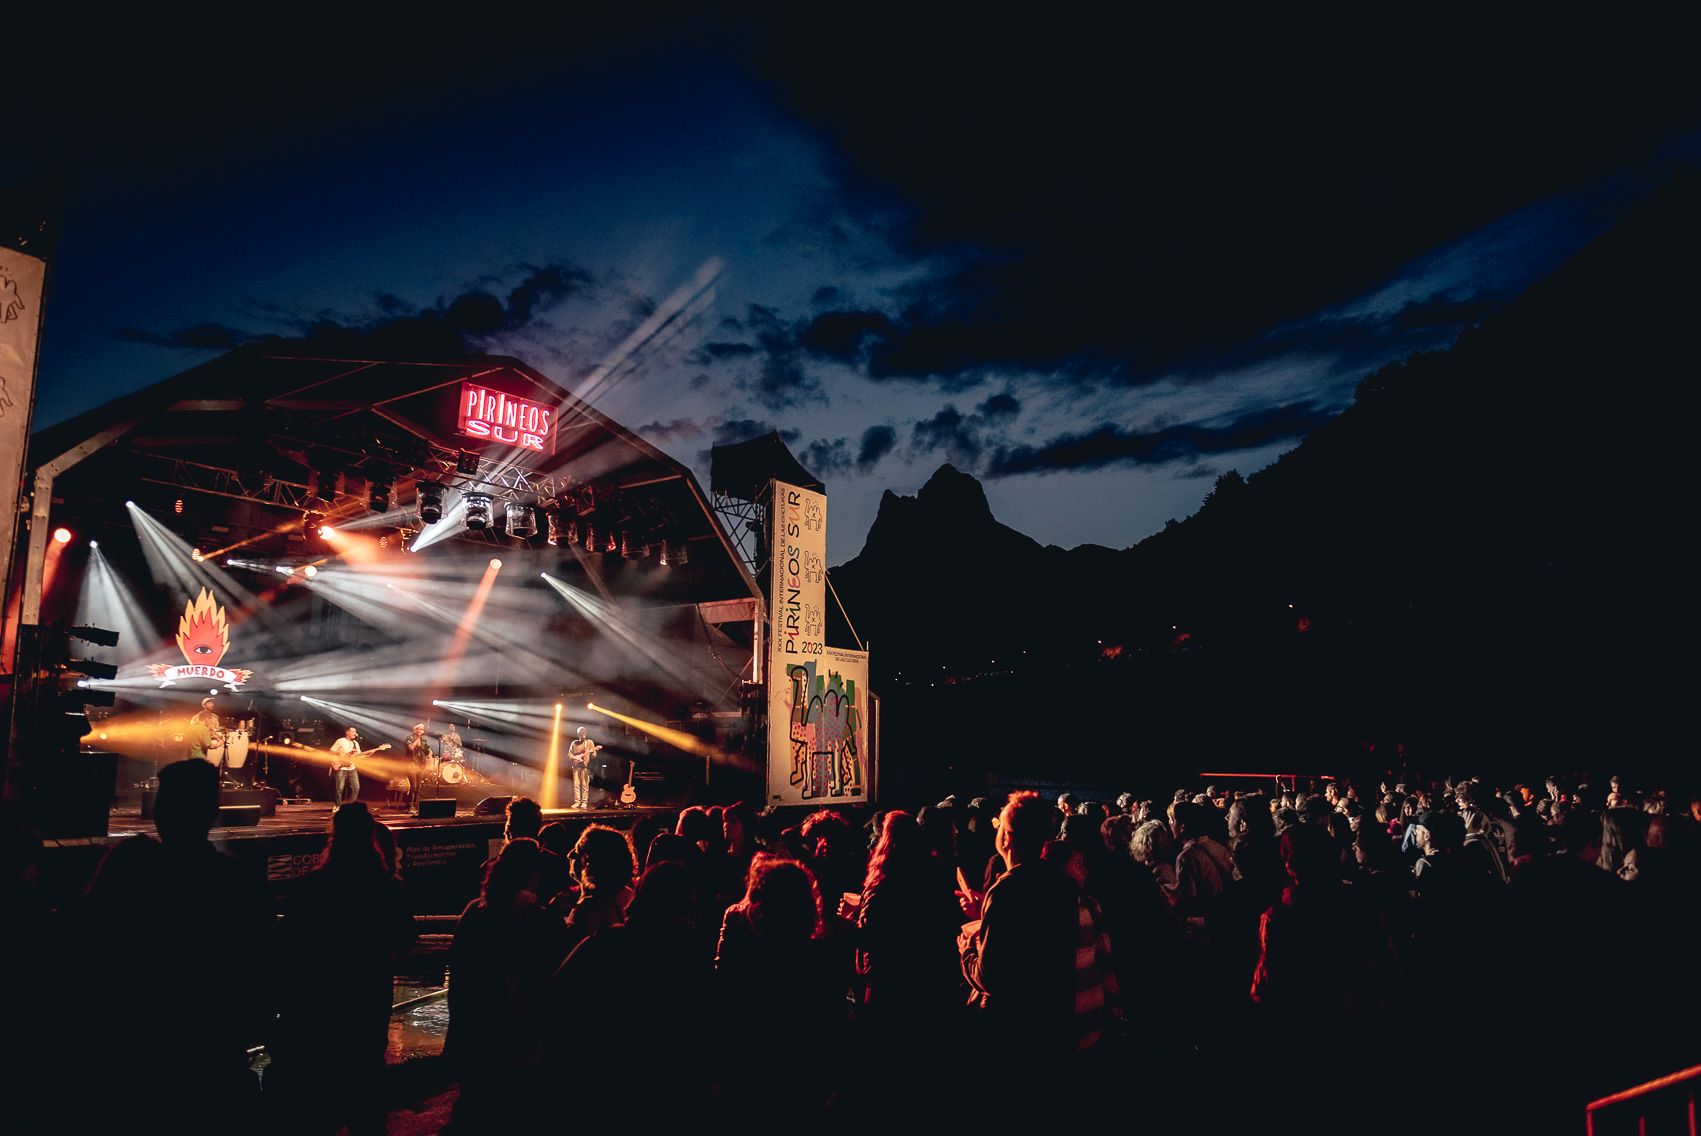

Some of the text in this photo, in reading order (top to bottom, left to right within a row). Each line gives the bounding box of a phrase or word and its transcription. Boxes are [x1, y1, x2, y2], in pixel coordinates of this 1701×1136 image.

[467, 389, 550, 436] PIRINEOS
[466, 419, 544, 450] SUR
[780, 538, 786, 548] DE
[802, 641, 823, 655] 2023
[177, 666, 225, 679] MUERDO
